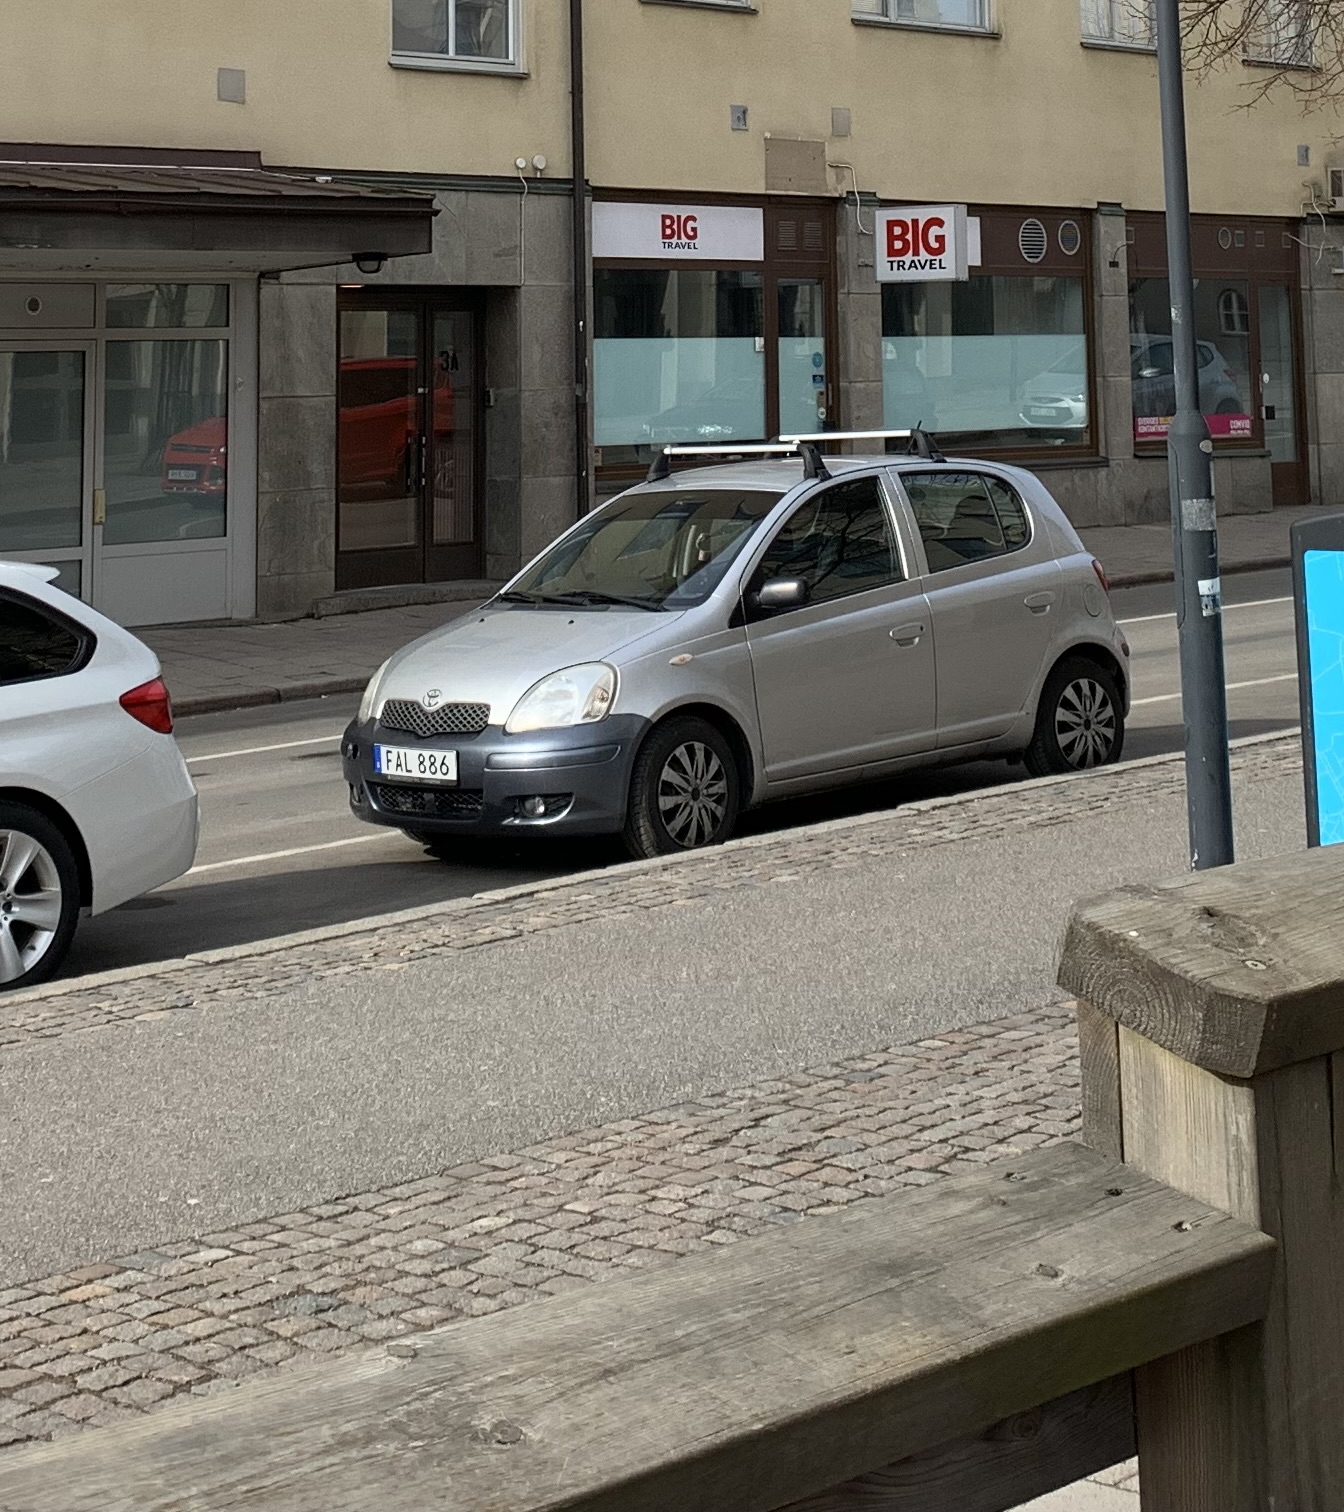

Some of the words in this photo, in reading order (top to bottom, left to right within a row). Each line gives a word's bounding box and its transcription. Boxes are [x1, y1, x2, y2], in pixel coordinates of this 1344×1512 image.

[661, 214, 698, 241] BIG
[886, 216, 946, 258] BIG
[661, 241, 699, 250] TRAVEL
[887, 258, 947, 271] TRAVEL
[438, 350, 460, 372] 3A
[386, 749, 413, 774] FAL
[417, 753, 450, 776] 886
